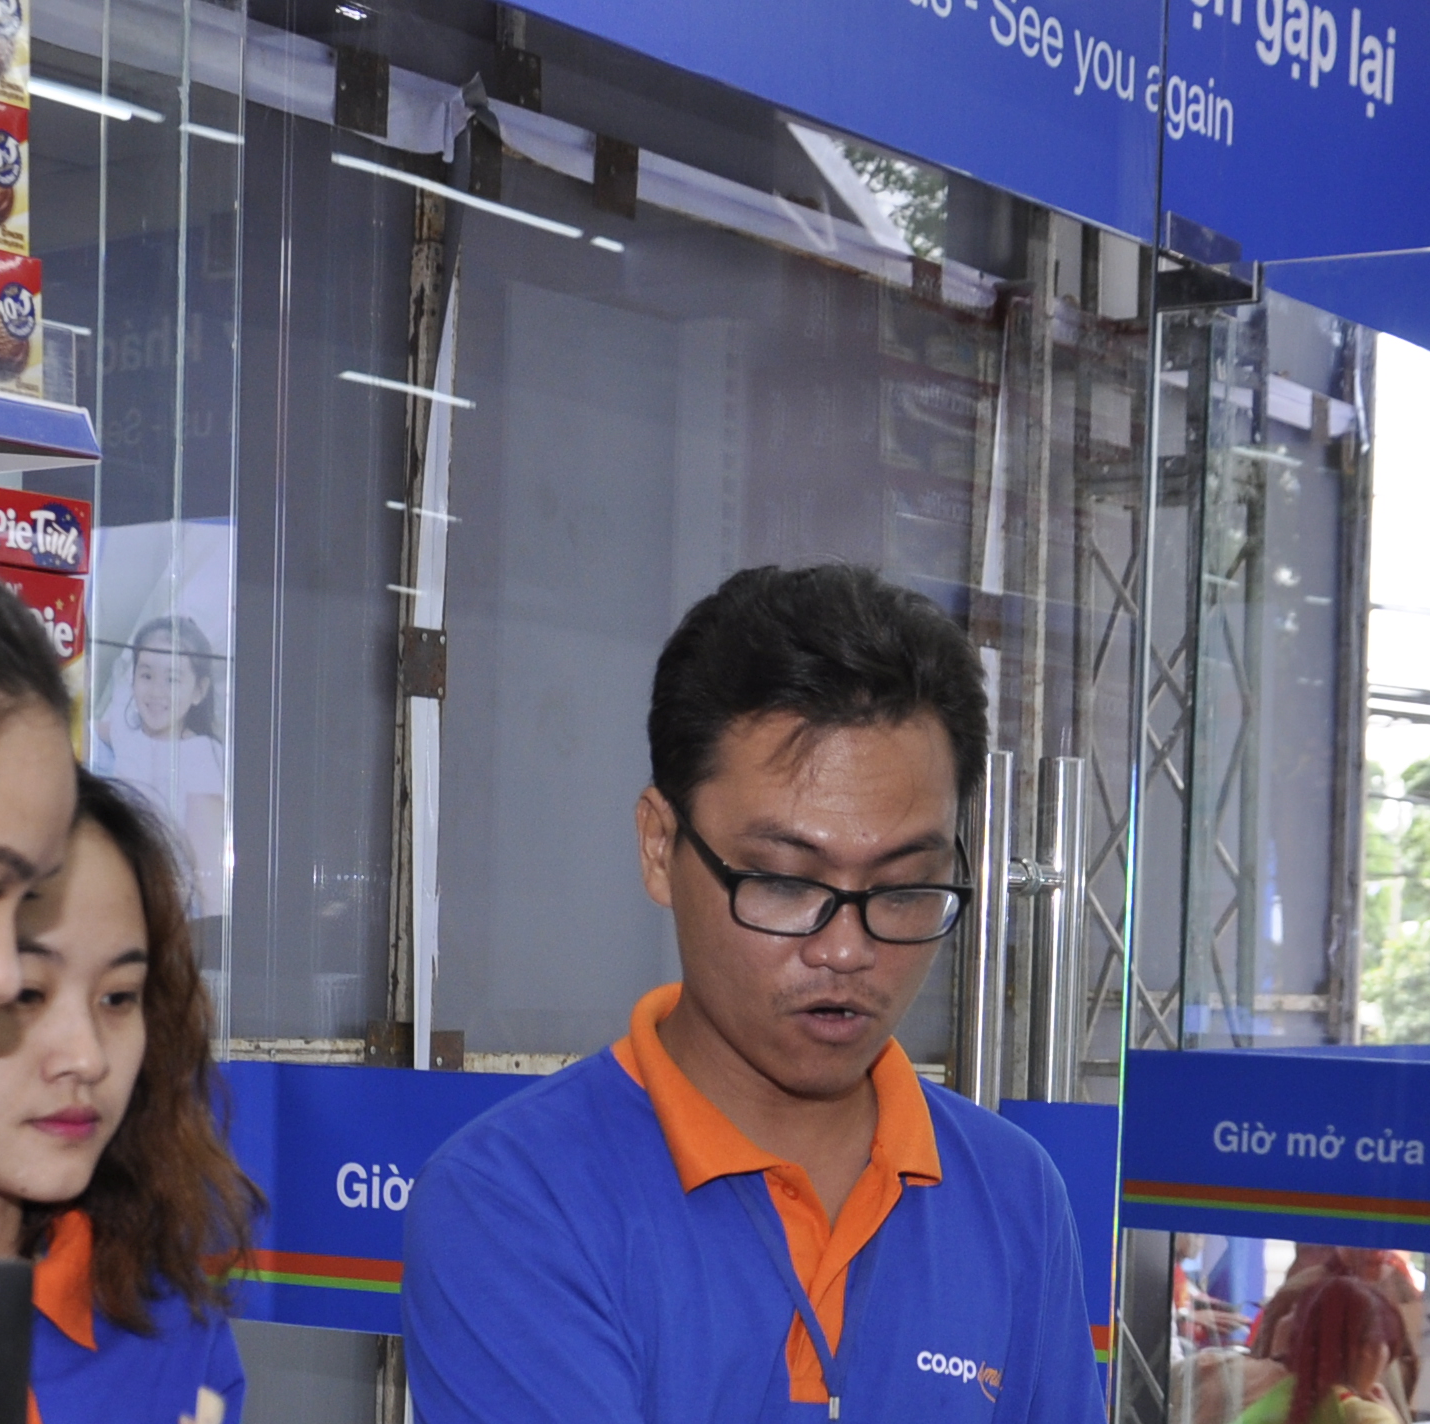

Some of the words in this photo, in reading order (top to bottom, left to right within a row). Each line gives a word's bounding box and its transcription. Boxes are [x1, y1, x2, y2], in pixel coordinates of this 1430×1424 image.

[990, 0, 1064, 68] See
[1074, 29, 1135, 101] you
[1145, 65, 1234, 146] again
[1349, 7, 1396, 119] lại
[1212, 1119, 1276, 1156] Giờ
[1286, 1123, 1346, 1161] mở
[1354, 1127, 1426, 1167] cửa
[336, 1161, 415, 1212] Giờ
